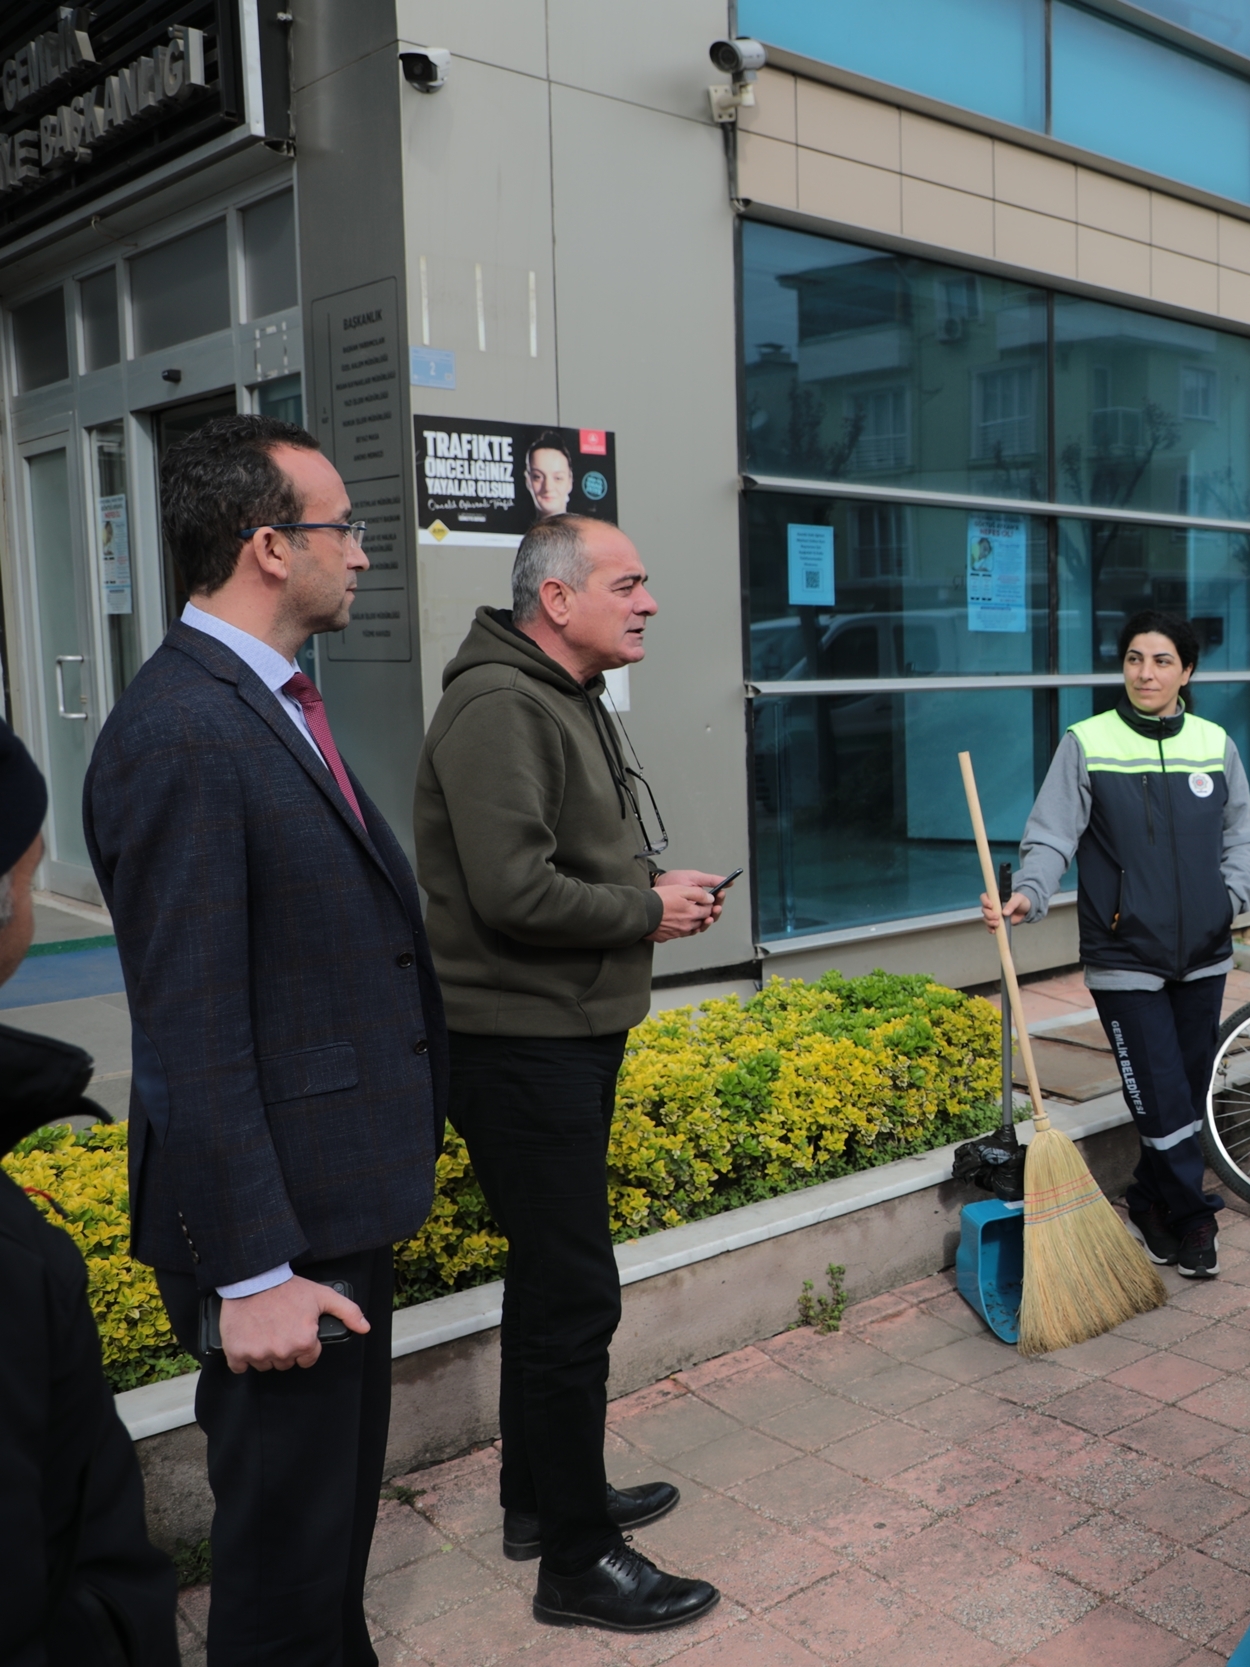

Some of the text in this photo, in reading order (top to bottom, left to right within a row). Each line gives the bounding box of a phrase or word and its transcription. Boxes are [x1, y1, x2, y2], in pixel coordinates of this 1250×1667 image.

[40, 25, 206, 167] BAŞKANLIĞI
[343, 309, 383, 331] BAŞKANLIK
[422, 430, 514, 462] TRAFİKTE
[424, 456, 515, 482] ÖNCELİĞİNİZ
[425, 478, 516, 499] YAYALAR OLSUN
[1111, 1020, 1128, 1058] GEMLİK
